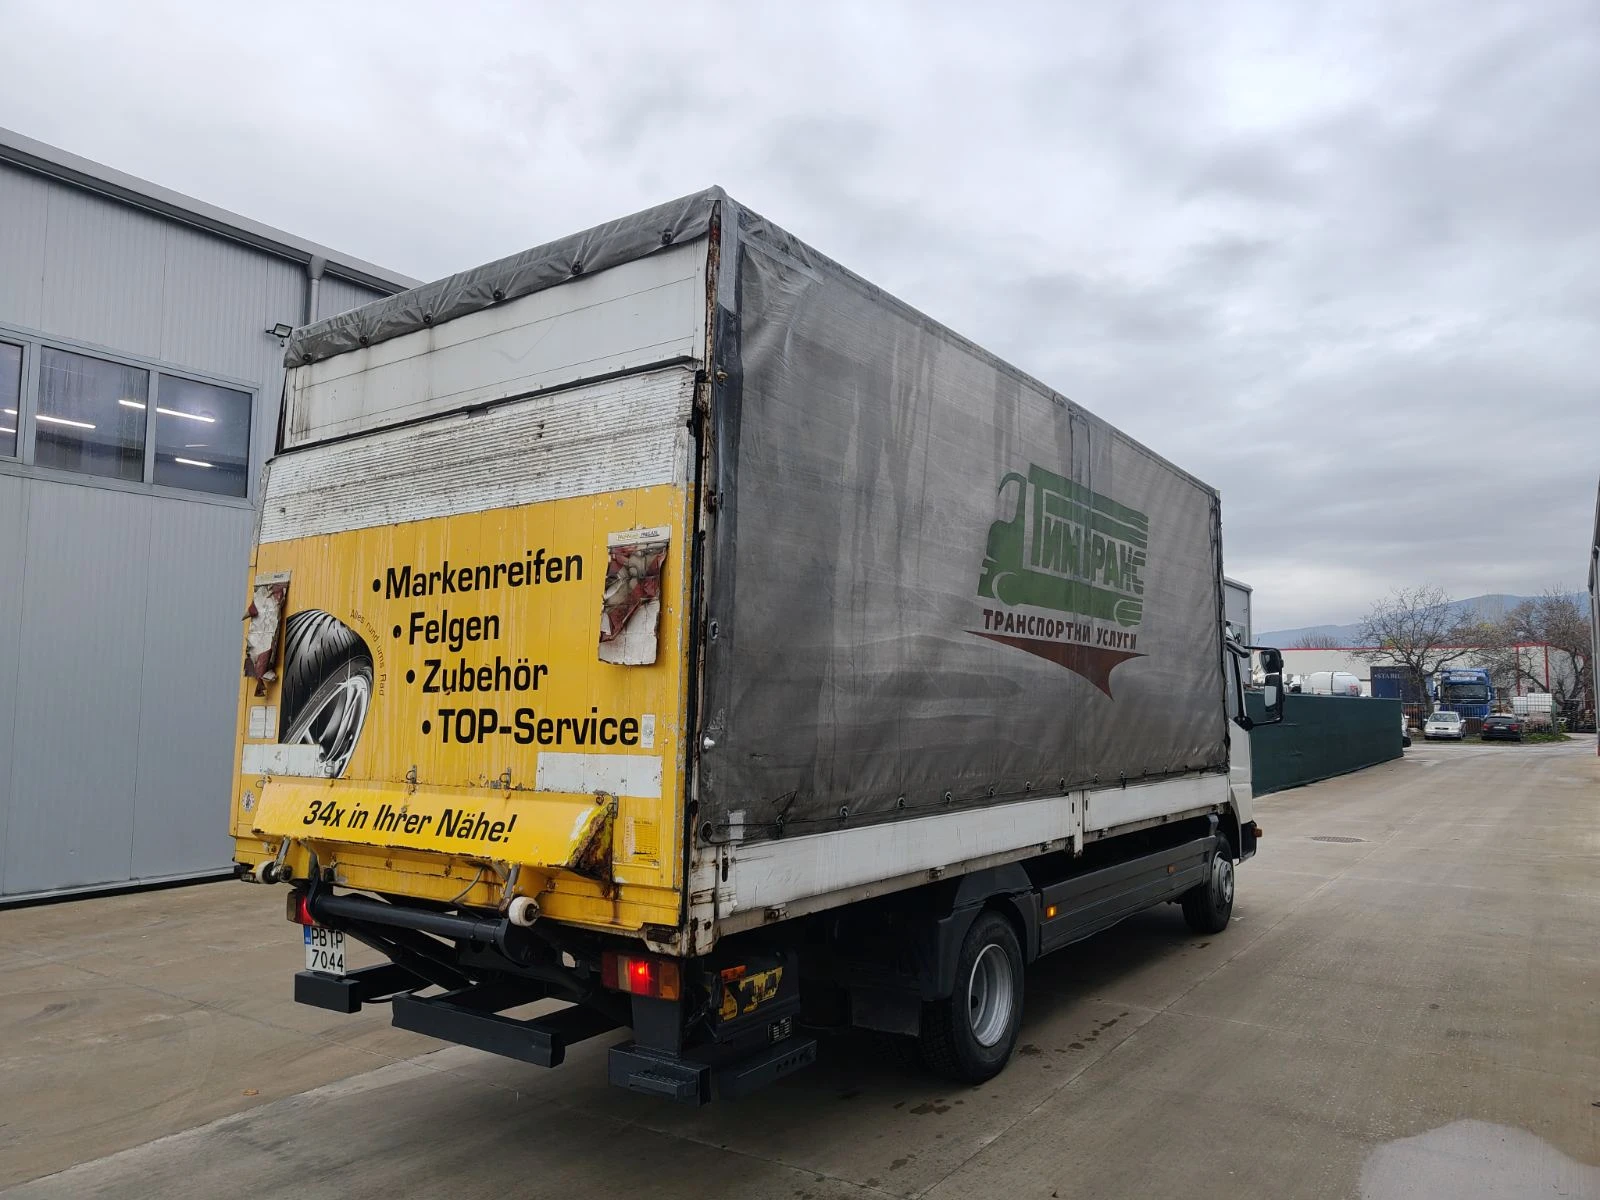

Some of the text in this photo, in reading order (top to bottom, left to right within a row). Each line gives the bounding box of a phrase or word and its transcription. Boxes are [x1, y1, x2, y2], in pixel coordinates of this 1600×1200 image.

[385, 548, 583, 600] Markenreifen
[349, 608, 365, 624] Alles
[365, 621, 381, 642] rund
[408, 609, 500, 652] Felgen
[983, 608, 1137, 650] ТРАНСПОРТНИ УСЛУГИ
[422, 656, 548, 695] Zubehör
[438, 706, 639, 746] TOP-Service
[302, 799, 518, 843] 34x in Ihrer Nähe!
[311, 948, 344, 973] 7044
